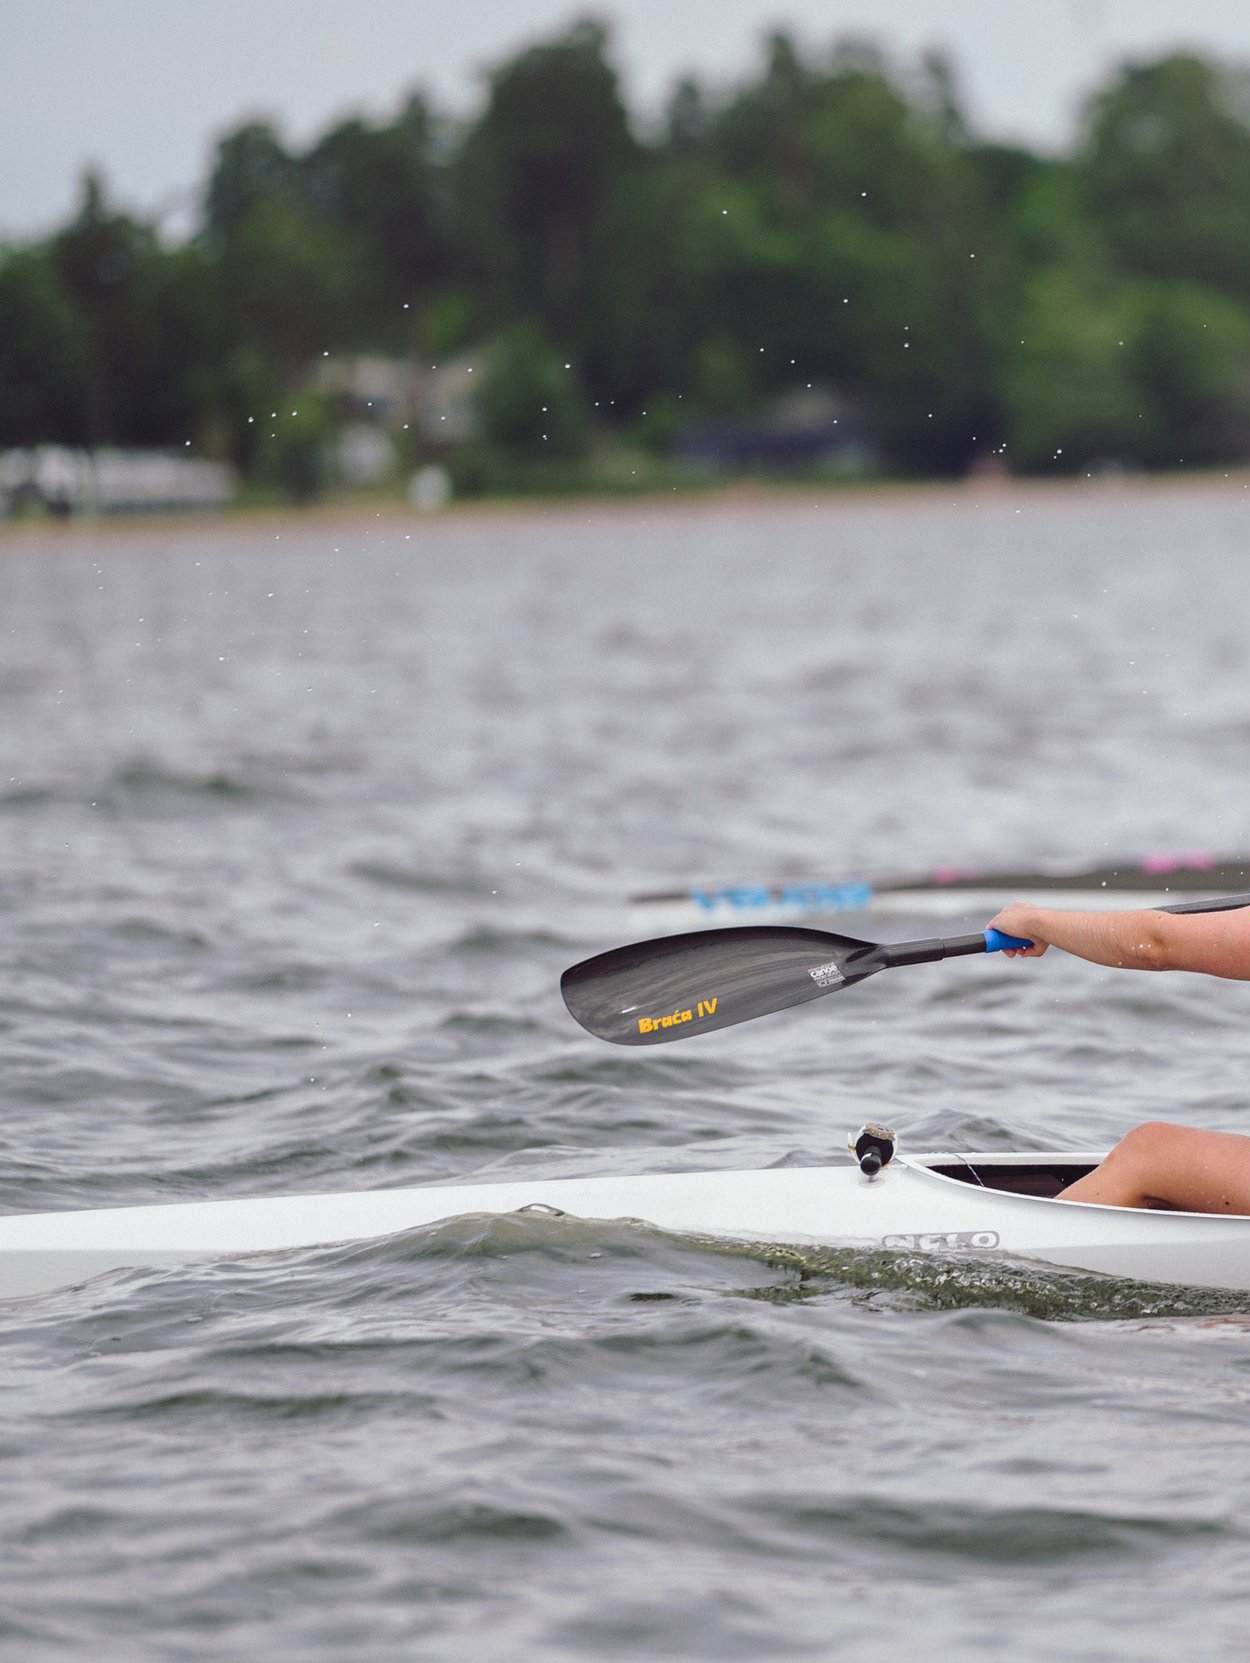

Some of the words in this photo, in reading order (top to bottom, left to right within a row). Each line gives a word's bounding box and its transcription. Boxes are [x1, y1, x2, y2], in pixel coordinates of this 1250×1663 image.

[810, 964, 838, 978] canoe
[638, 1009, 692, 1034] Braća
[697, 998, 718, 1017] IV
